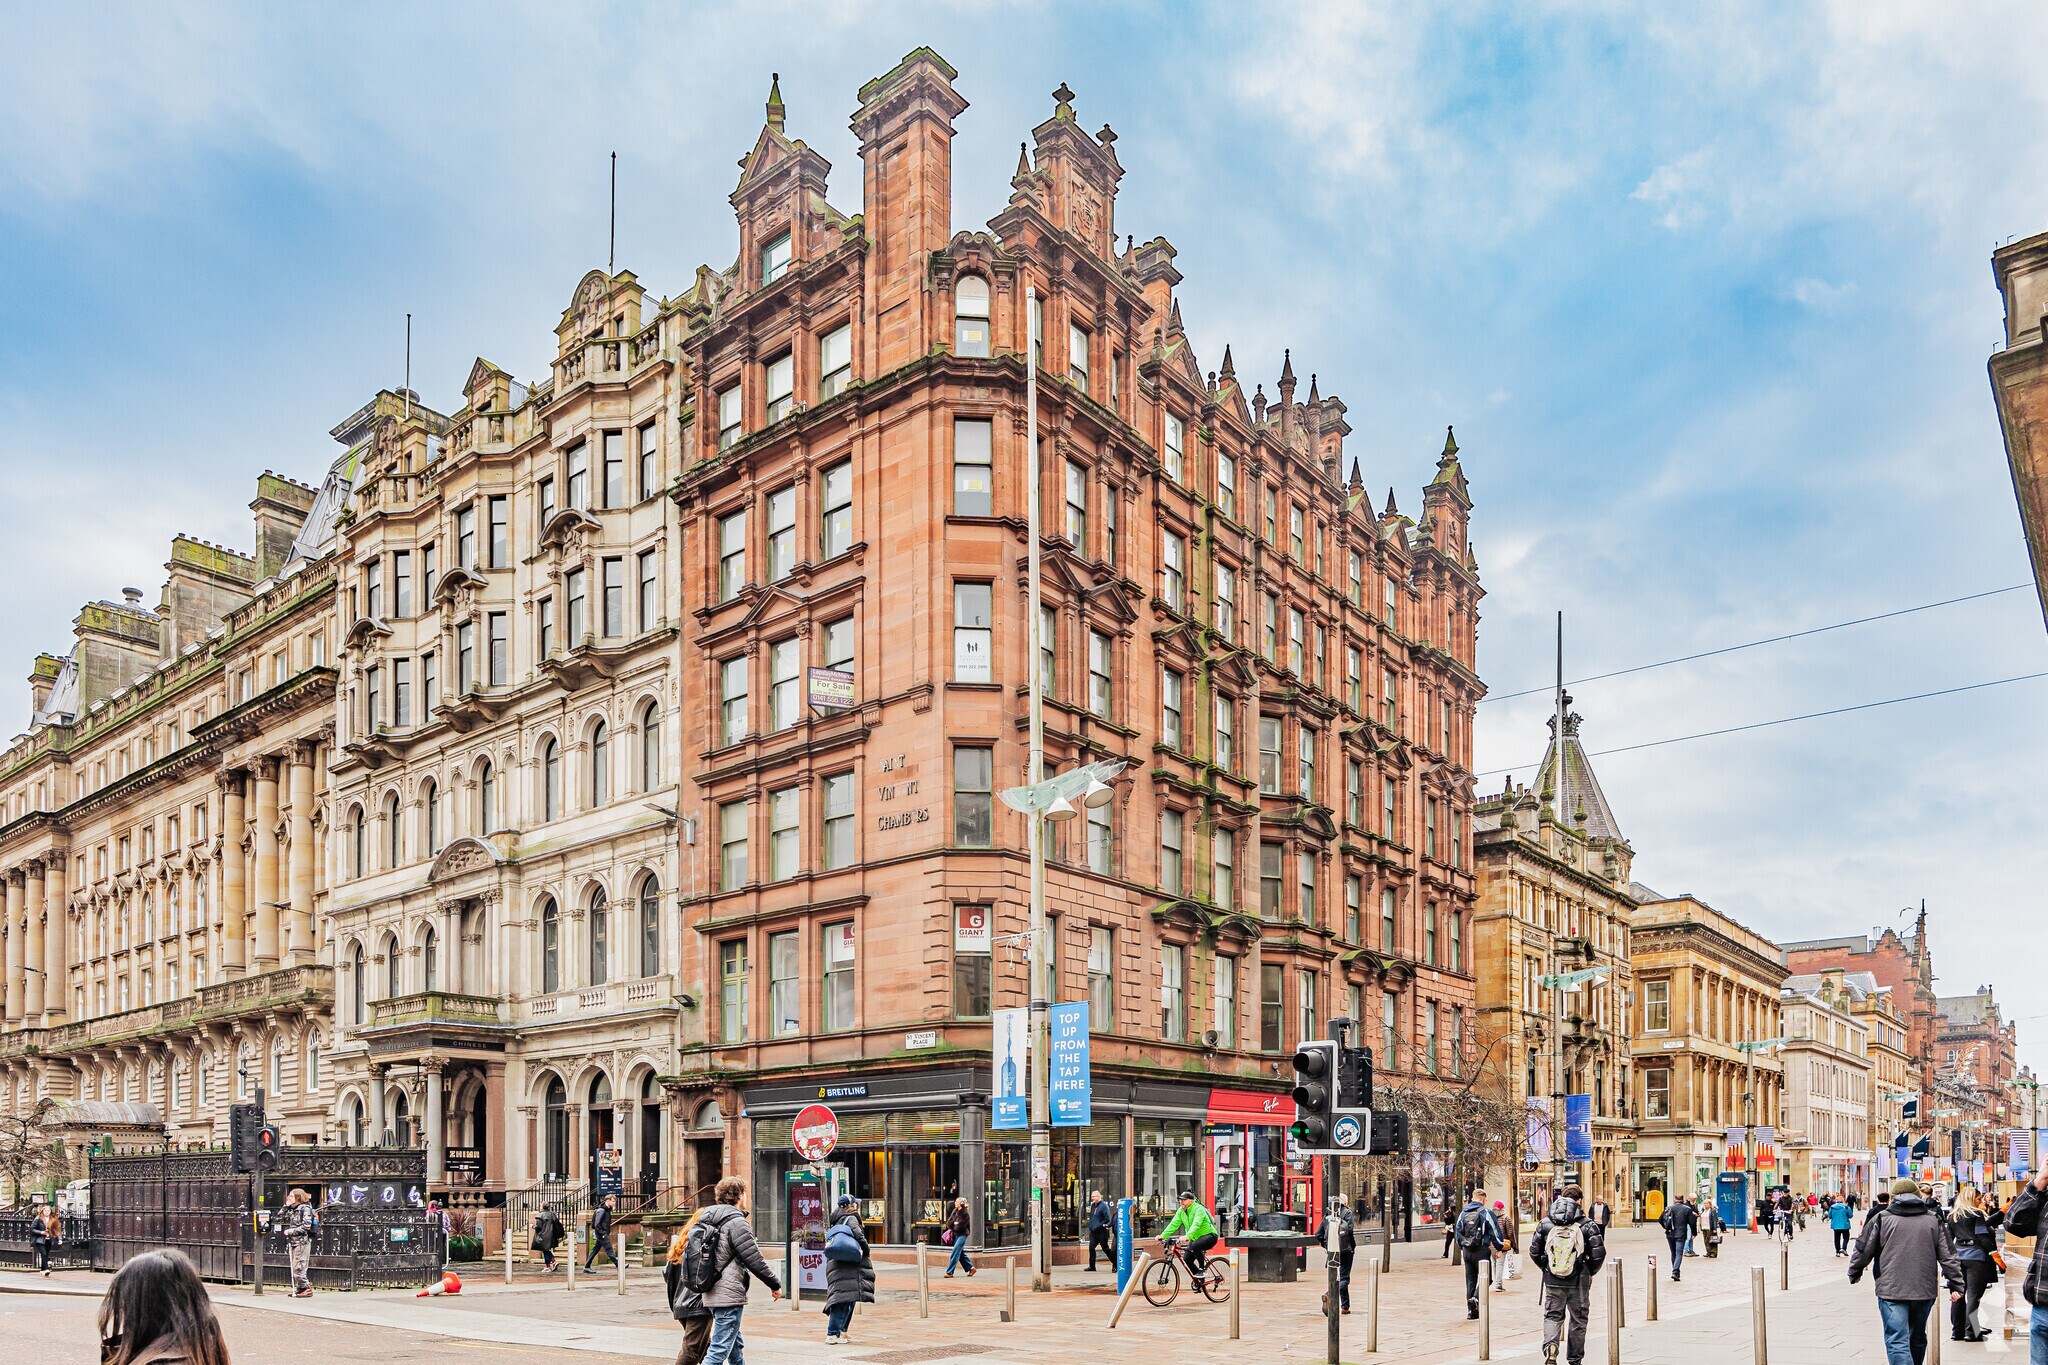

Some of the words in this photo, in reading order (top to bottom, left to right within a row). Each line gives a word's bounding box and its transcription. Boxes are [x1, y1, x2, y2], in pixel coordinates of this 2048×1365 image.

[832, 682, 850, 690] Sale
[812, 694, 826, 702] 0141
[880, 753, 906, 772] AIT
[878, 780, 919, 802] VINNT
[878, 808, 930, 832] CHAMBRS
[1059, 1012, 1080, 1024] TOP
[1062, 1026, 1077, 1037] UP
[1054, 1039, 1086, 1051] FROM
[1058, 1053, 1080, 1064] THE
[1060, 1066, 1080, 1077] TAP
[1054, 1080, 1085, 1090] HERE
[826, 1086, 866, 1096] BREITLING
